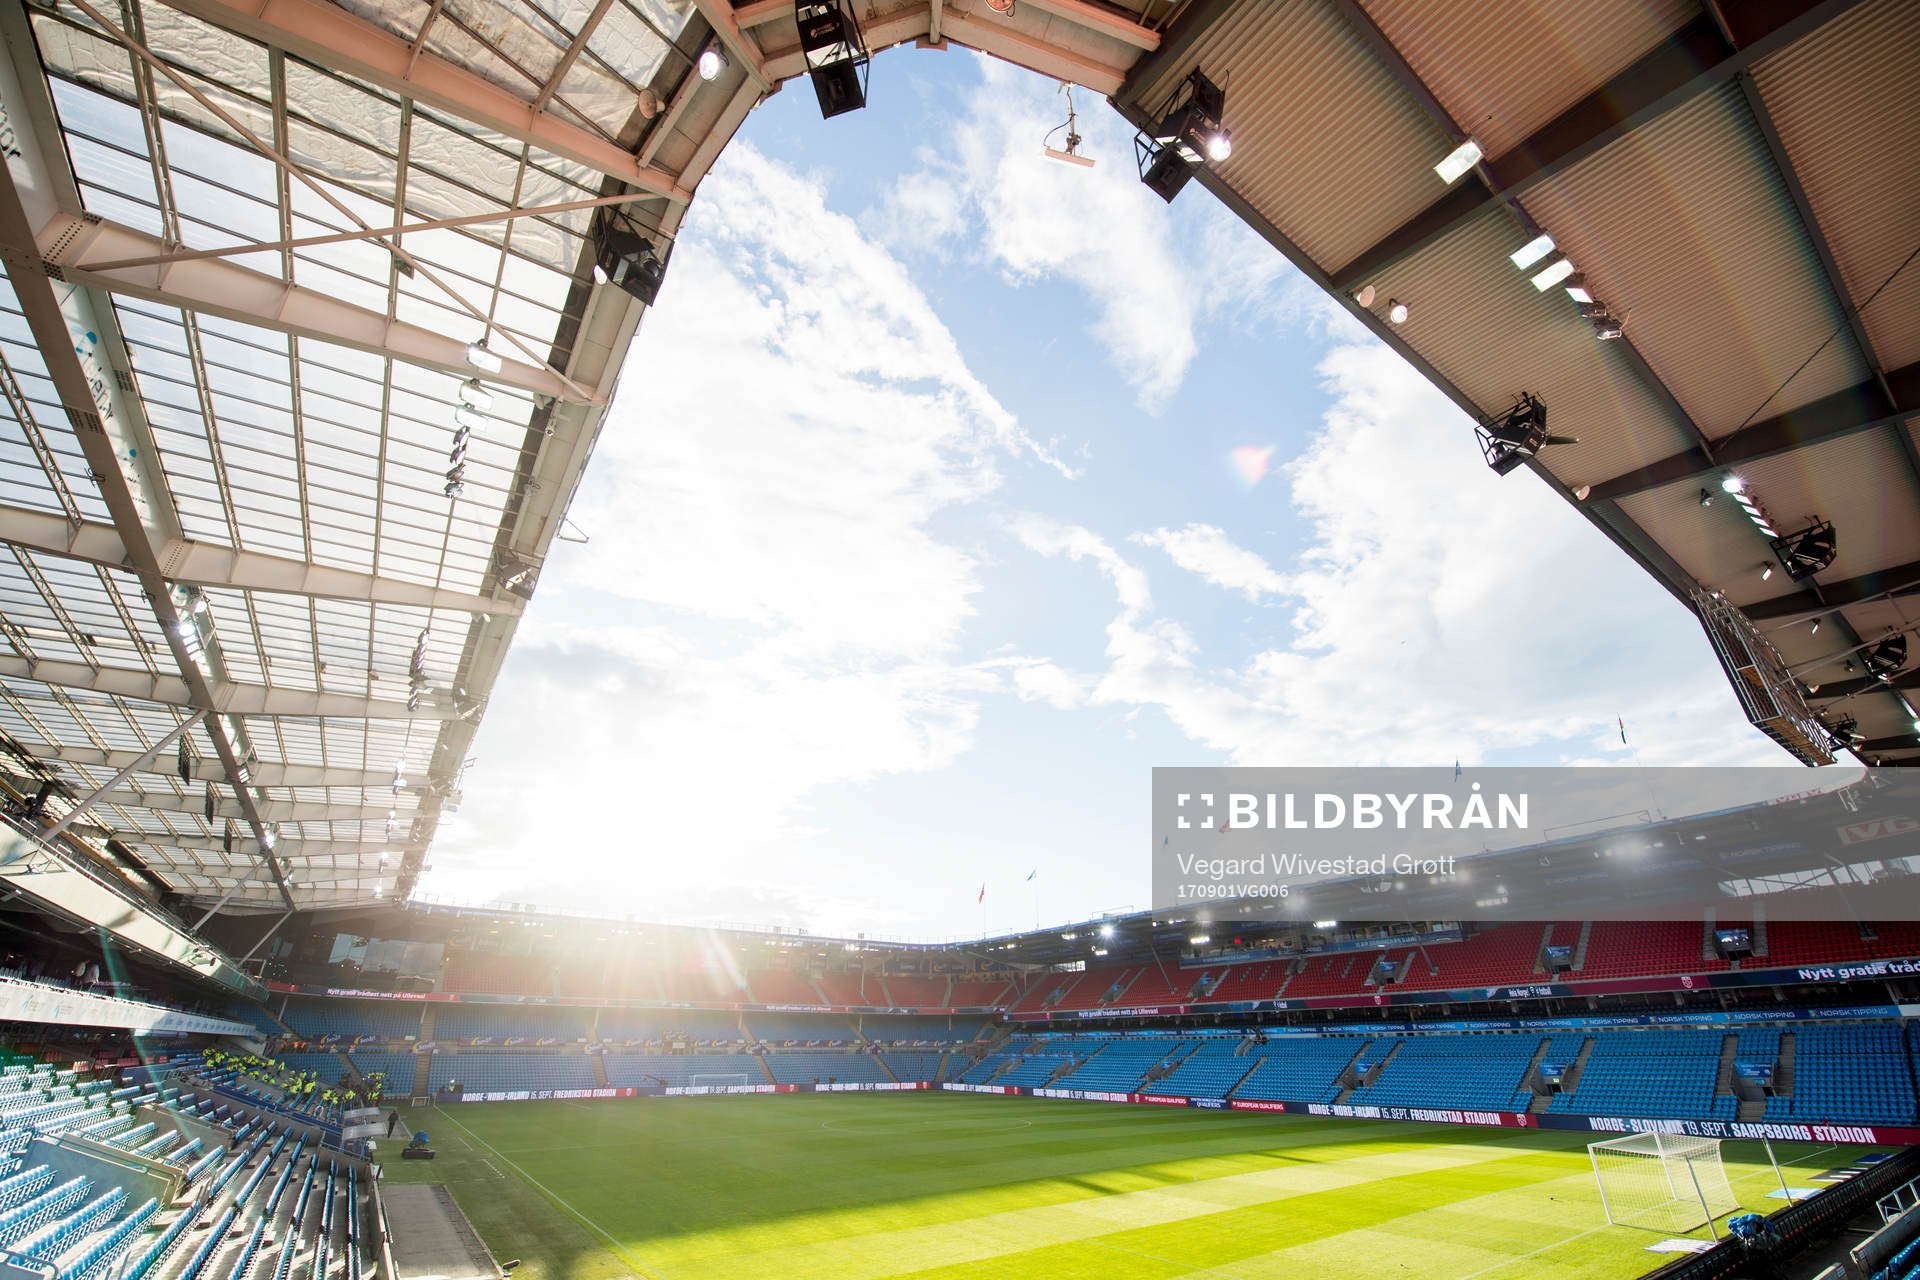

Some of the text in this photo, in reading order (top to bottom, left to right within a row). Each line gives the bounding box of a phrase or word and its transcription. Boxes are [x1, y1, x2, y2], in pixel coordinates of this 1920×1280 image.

[1798, 967, 1836, 981] Nytt
[1838, 963, 1887, 979] gratis
[1764, 1011, 1795, 1019] TIPPING
[1820, 1007, 1888, 1017] NORSK TIPPING
[1237, 1101, 1259, 1109] EUROPEAN
[1381, 1107, 1391, 1119] 15.
[1391, 1107, 1410, 1120] SEPT.
[1410, 1108, 1463, 1123] FREDRIKSTAD
[1463, 1111, 1501, 1125] STADION
[1685, 1120, 1703, 1135] 19.
[1703, 1121, 1731, 1138] SEPT.
[1730, 1122, 1812, 1140] SARPSBORG
[1812, 1125, 1877, 1144] STADION
